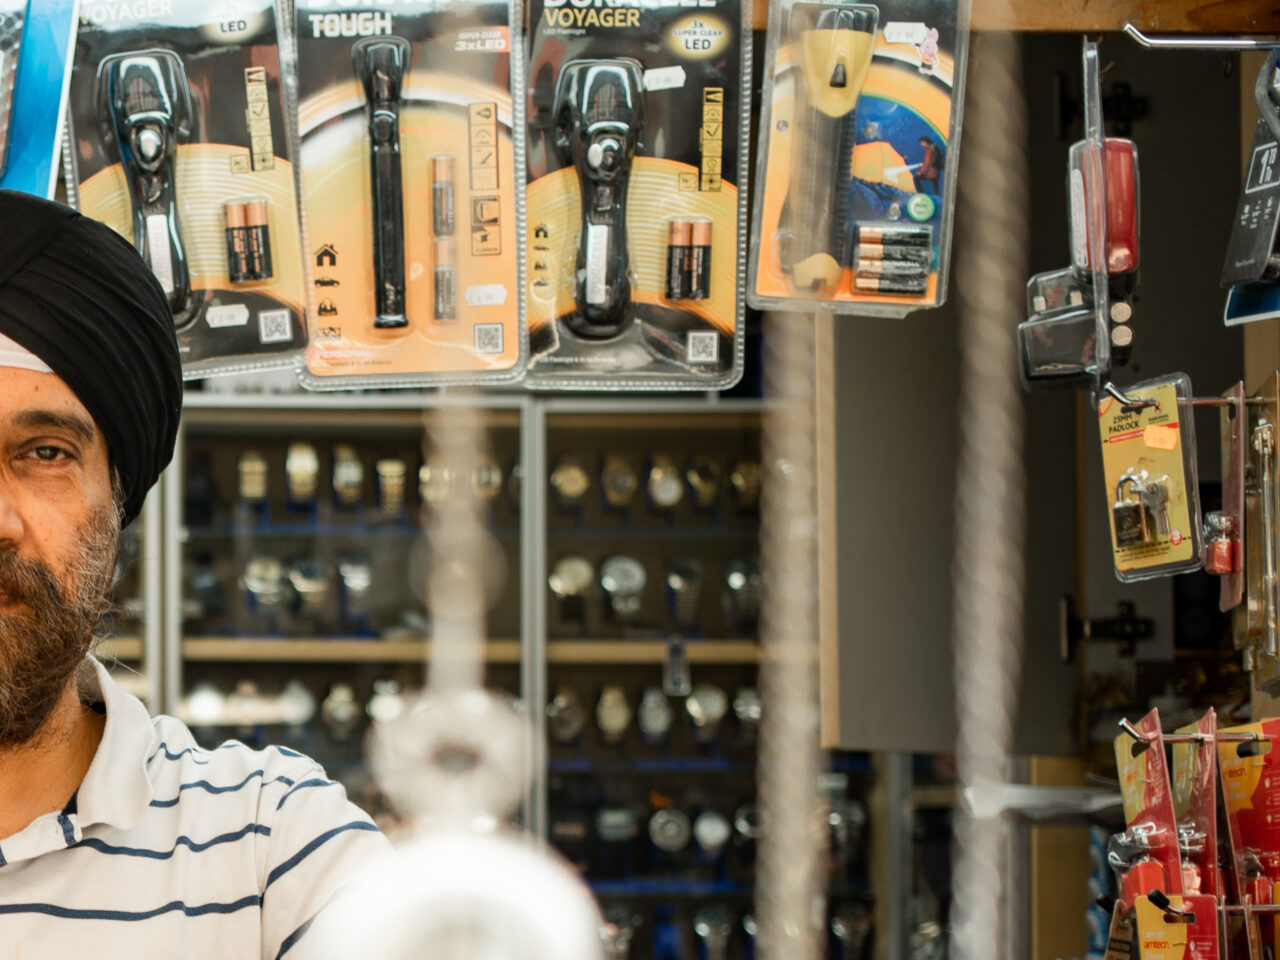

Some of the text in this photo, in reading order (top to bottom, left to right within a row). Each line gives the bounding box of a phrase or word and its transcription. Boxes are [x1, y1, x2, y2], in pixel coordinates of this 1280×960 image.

[544, 8, 641, 28] VOYAGER
[691, 19, 705, 29] 3x
[219, 19, 248, 33] LED
[308, 12, 393, 38] TOUGH
[454, 38, 507, 51] 3xLED
[685, 38, 712, 50] LED
[1113, 413, 1133, 424] 25MM
[1108, 420, 1140, 434] PADLOCK
